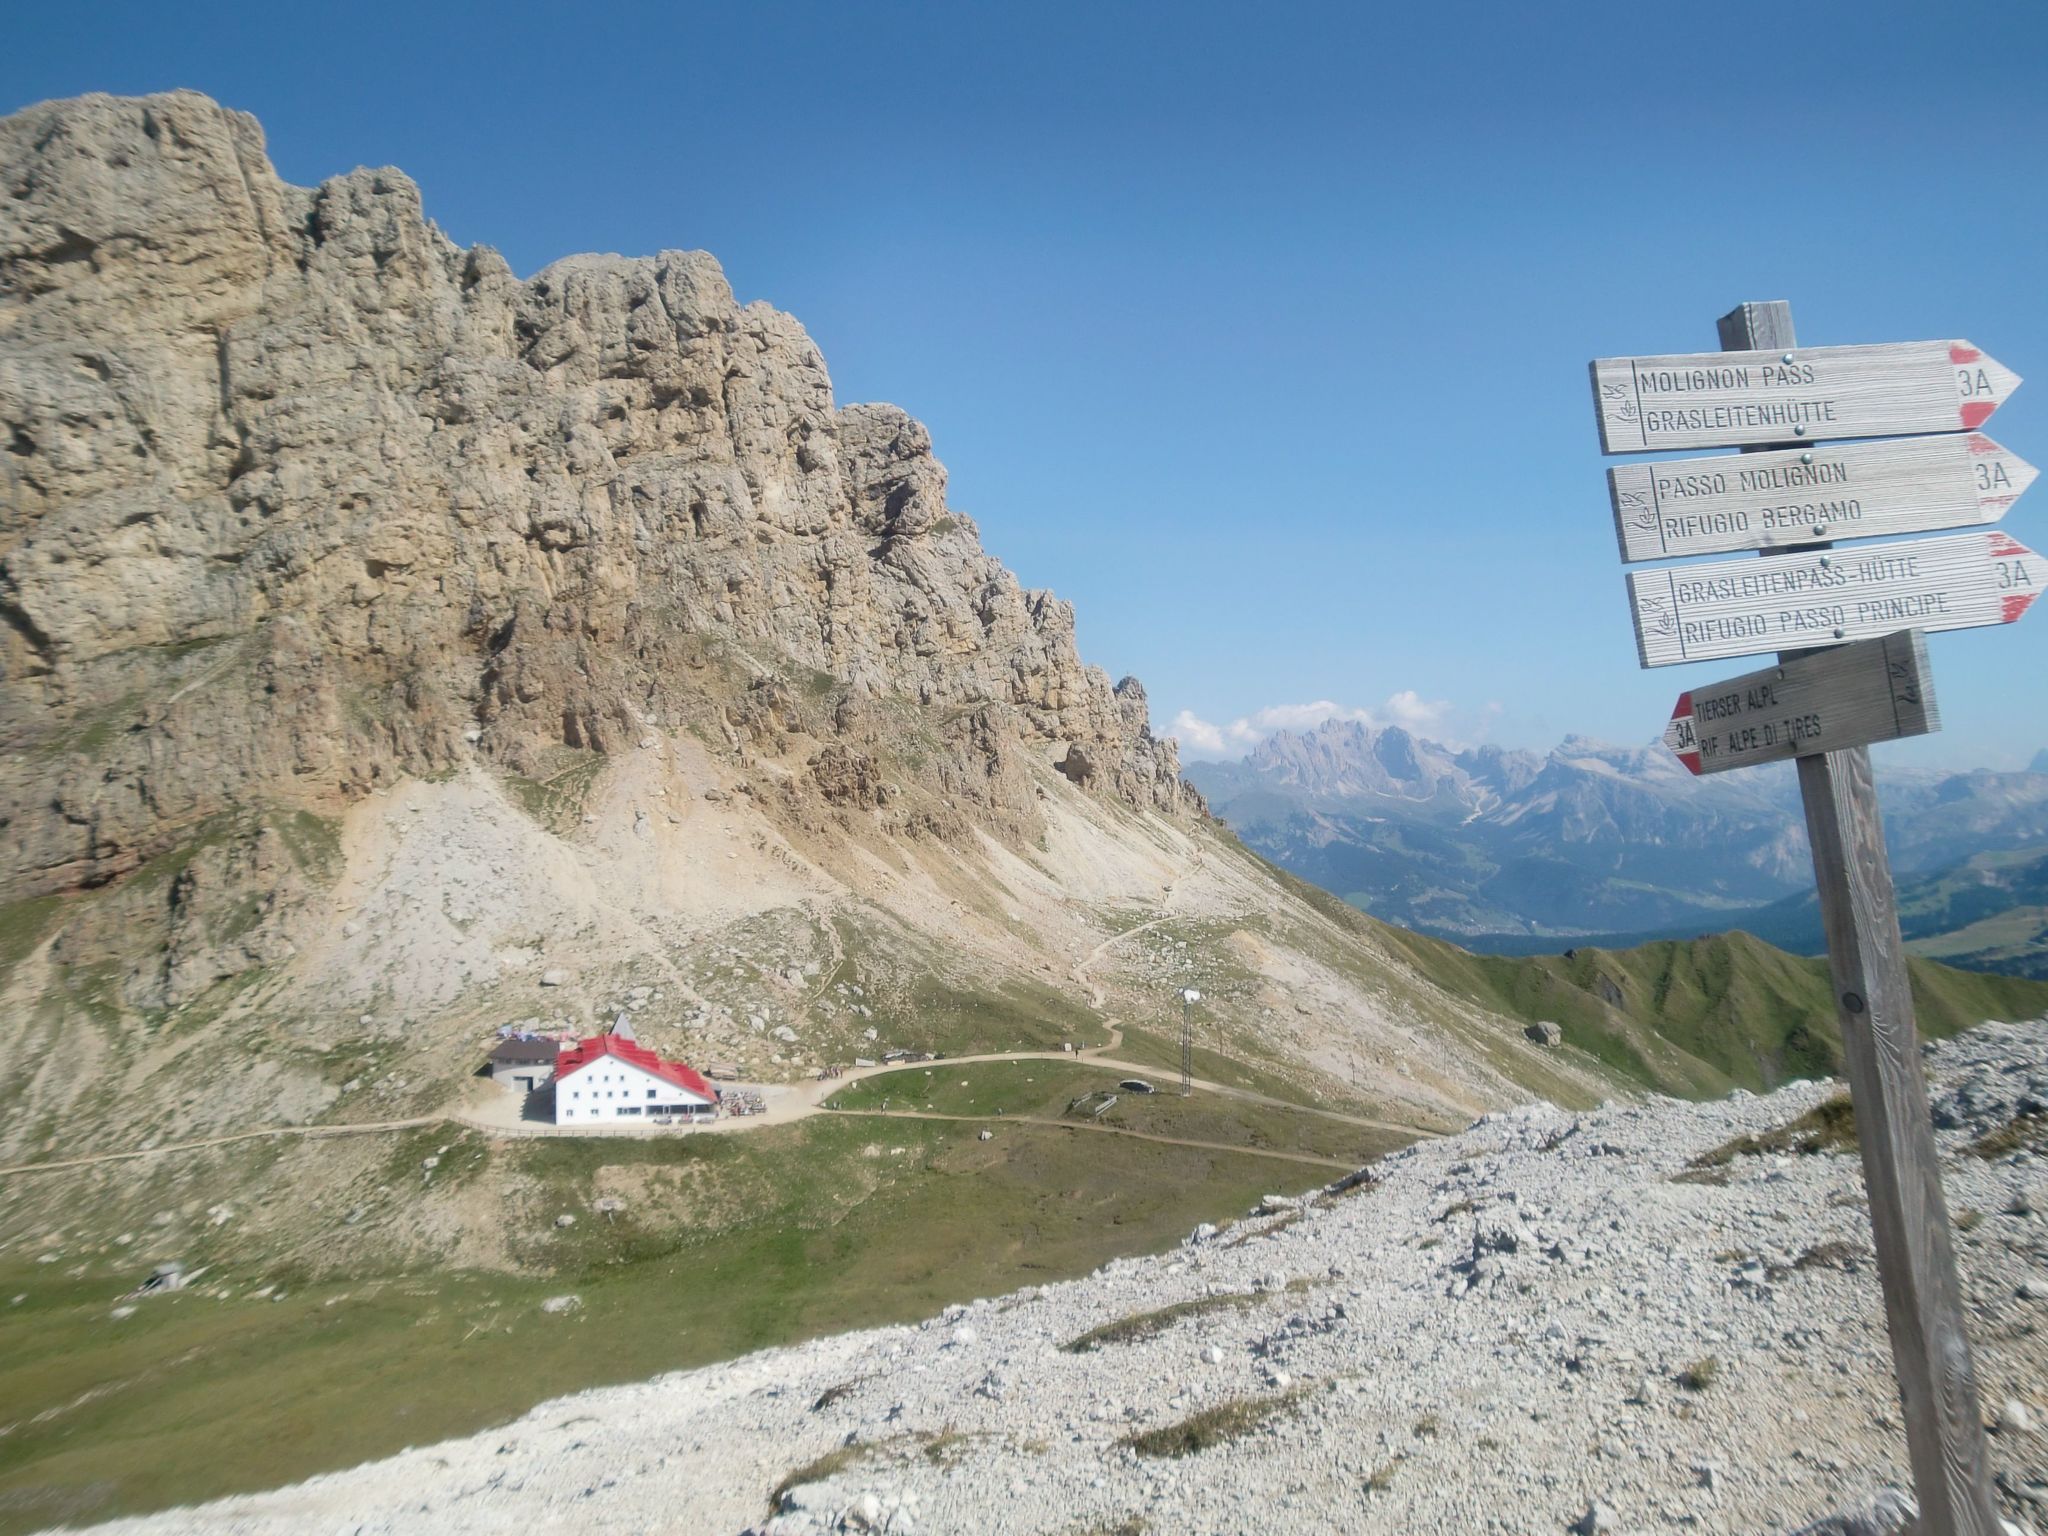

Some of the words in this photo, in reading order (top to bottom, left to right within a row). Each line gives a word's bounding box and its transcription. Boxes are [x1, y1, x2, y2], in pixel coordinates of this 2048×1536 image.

[1640, 368, 1749, 393] MOLIGNON
[1762, 364, 1815, 387] PASS
[1959, 368, 1994, 398] 3A
[1647, 398, 1837, 432] GRASLEITENHÜTTE
[1658, 473, 1726, 500] PASSO
[1739, 462, 1848, 493] MOLIGNON
[1976, 462, 2012, 492] 3A
[1665, 511, 1749, 539] RIFUGIO
[1762, 499, 1862, 529] BERGAMO
[1678, 556, 1921, 604] GRASLEITENPASS-HÜTTE
[1994, 560, 2031, 590] 3A
[1684, 613, 1767, 644] RIFUGIO
[1779, 605, 1845, 633] PASSO
[1858, 592, 1951, 622] PRINCIPE
[1695, 694, 1741, 723] TIERSER
[1675, 721, 1696, 749] 3A
[1701, 736, 1723, 759] RIF.
[1729, 728, 1759, 753] ALPE
[1764, 724, 1778, 746] DI
[1784, 714, 1822, 743] TIRES
